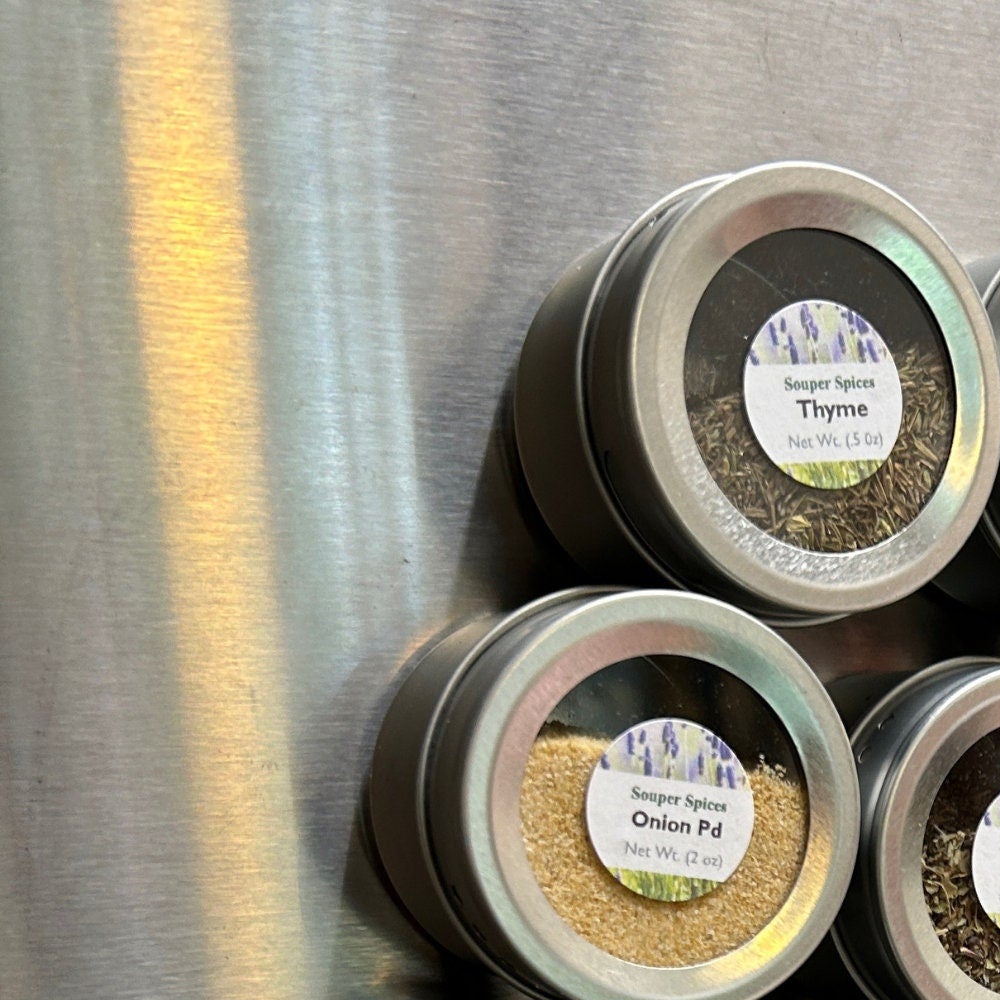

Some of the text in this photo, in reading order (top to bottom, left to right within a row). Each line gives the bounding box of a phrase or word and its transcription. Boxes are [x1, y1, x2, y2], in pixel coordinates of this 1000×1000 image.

[784, 375, 875, 394] Souper Spices
[796, 399, 868, 424] Thyme
[788, 434, 813, 449] Net
[631, 786, 727, 812] Souper Spices
[632, 811, 722, 838] Onion Pd
[625, 841, 650, 858] Net
[686, 851, 698, 867] (2
[703, 855, 723, 870] oz)
